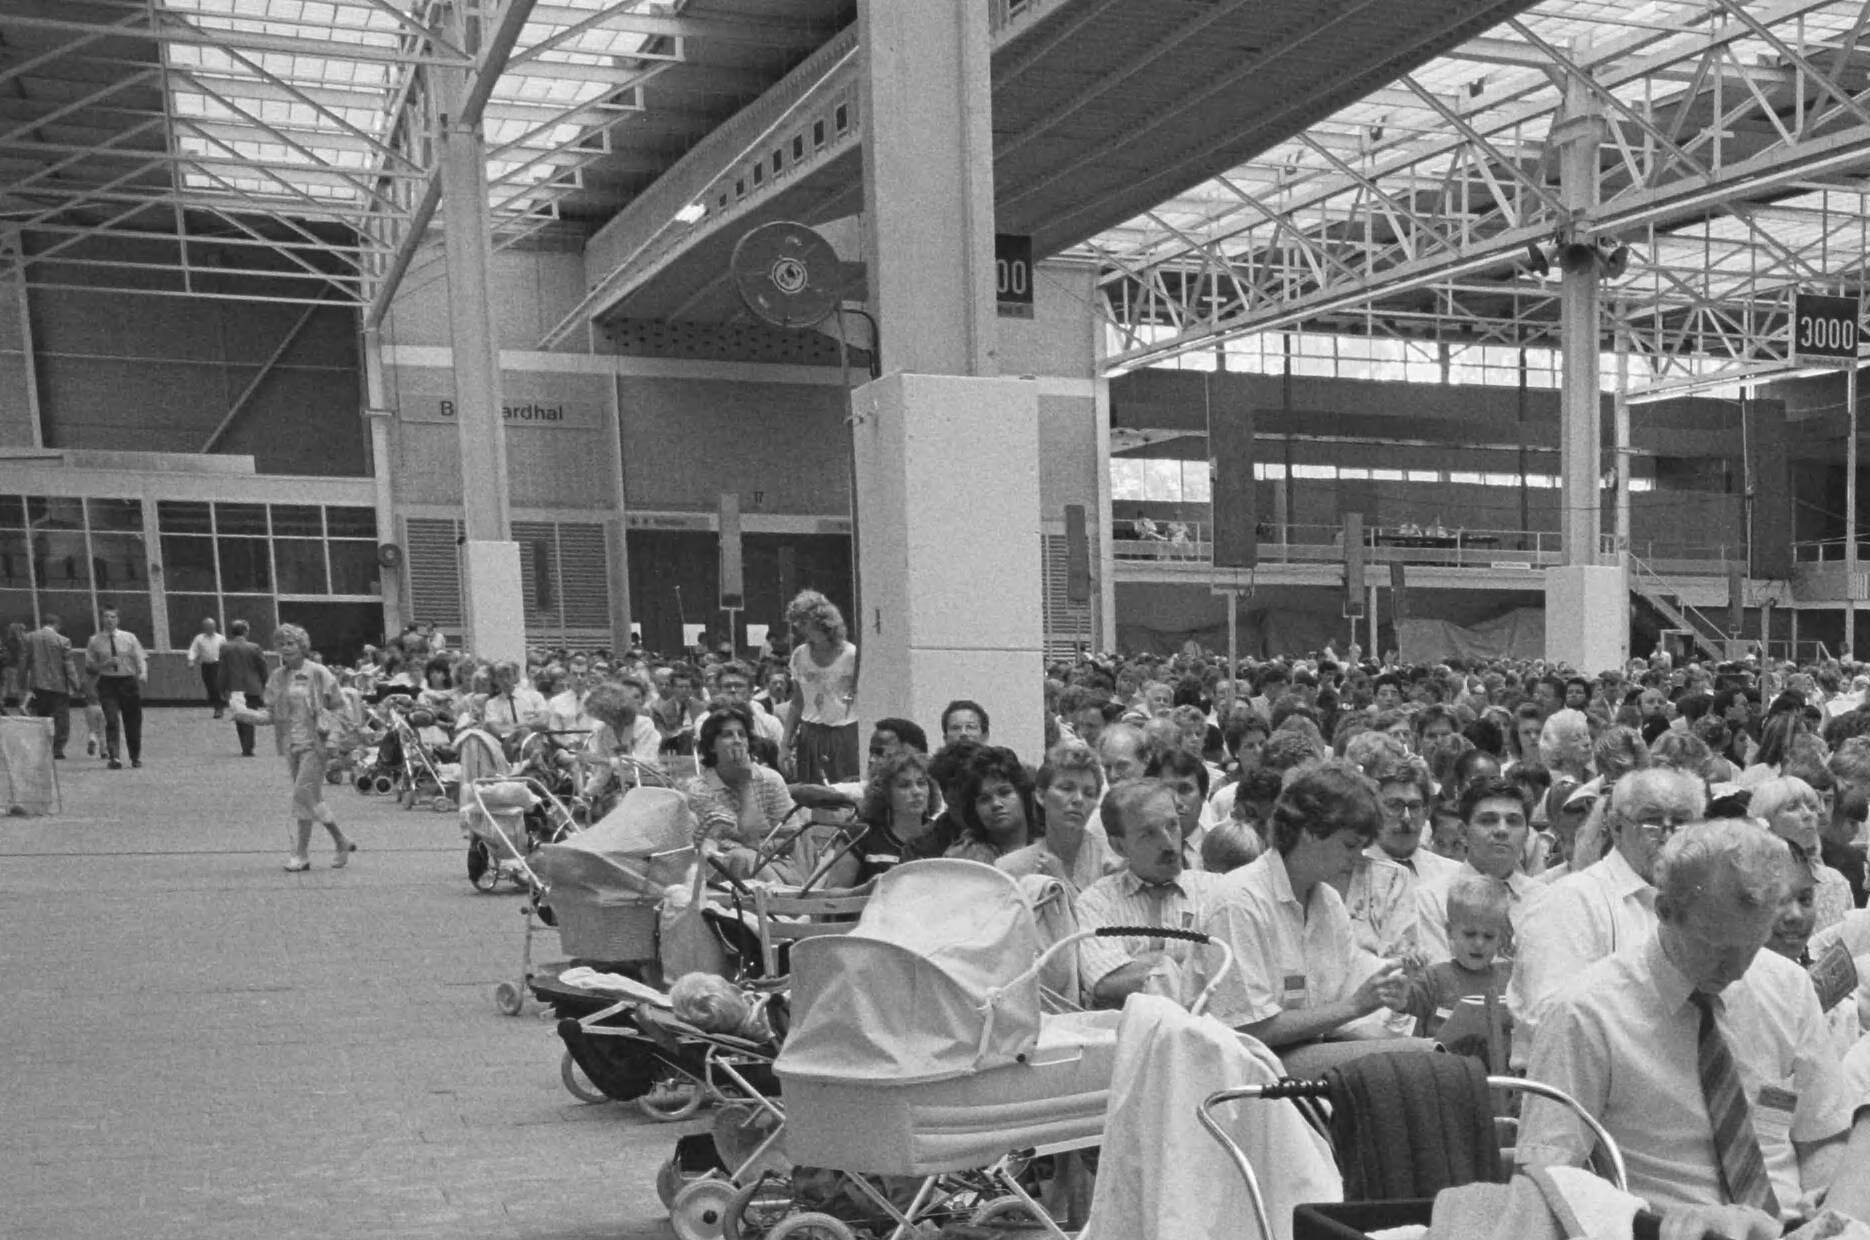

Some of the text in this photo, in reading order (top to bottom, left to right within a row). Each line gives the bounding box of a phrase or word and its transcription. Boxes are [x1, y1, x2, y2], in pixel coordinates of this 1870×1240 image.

[996, 259, 1026, 295] 00
[1801, 316, 1854, 350] 3000
[440, 400, 564, 421] Bardhal
